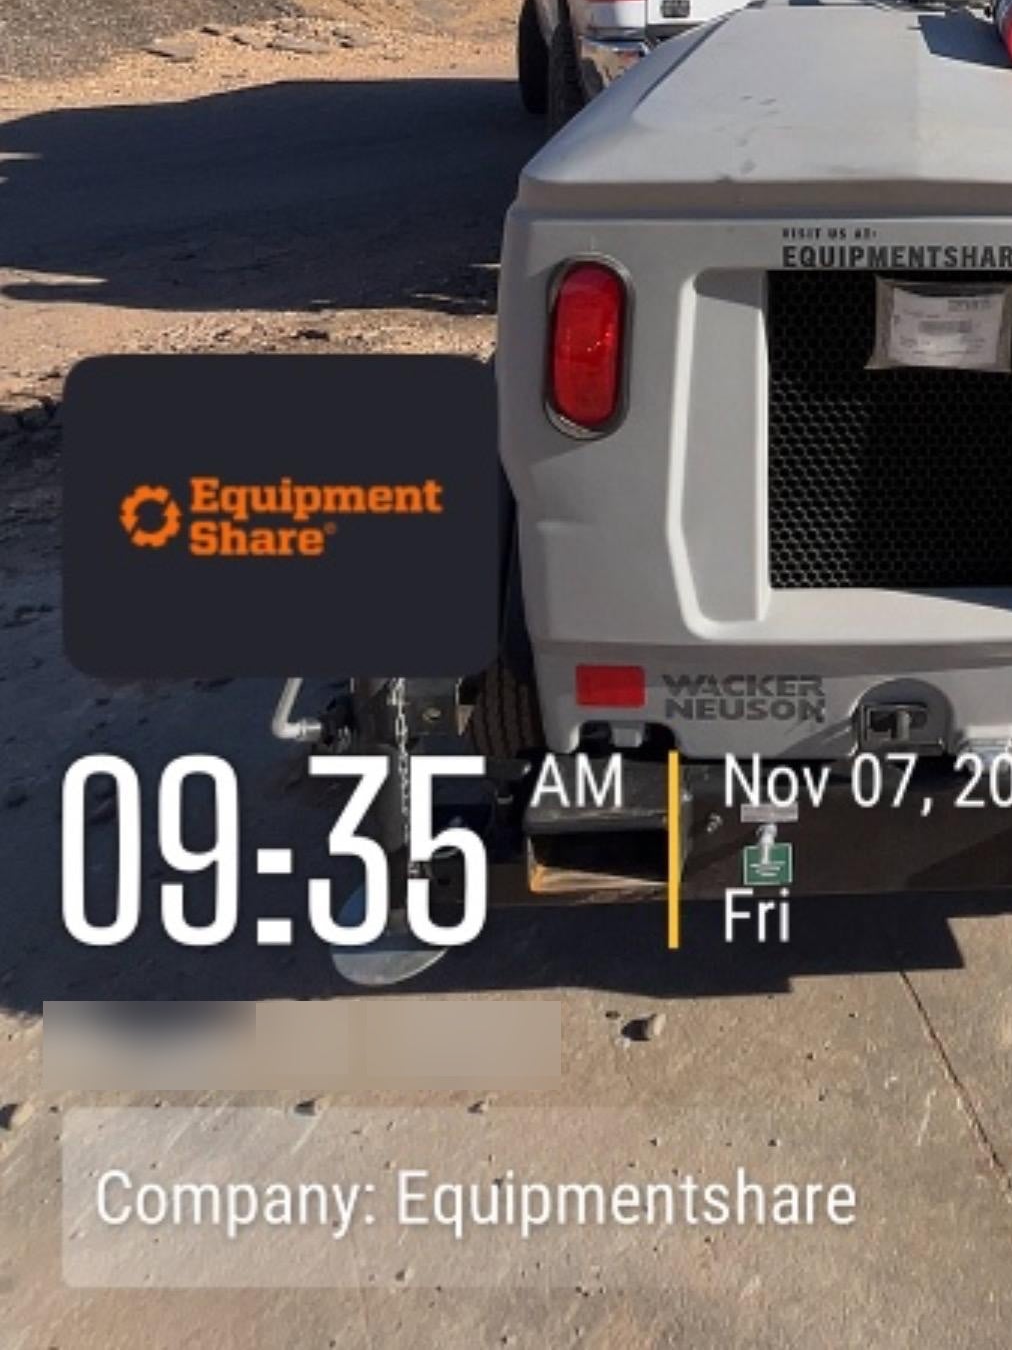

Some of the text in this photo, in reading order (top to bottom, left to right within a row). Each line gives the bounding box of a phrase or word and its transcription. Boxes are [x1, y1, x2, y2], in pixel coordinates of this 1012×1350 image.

[827, 227, 847, 240] US
[662, 674, 826, 697] WACKER
[665, 699, 826, 723] NEUSON
